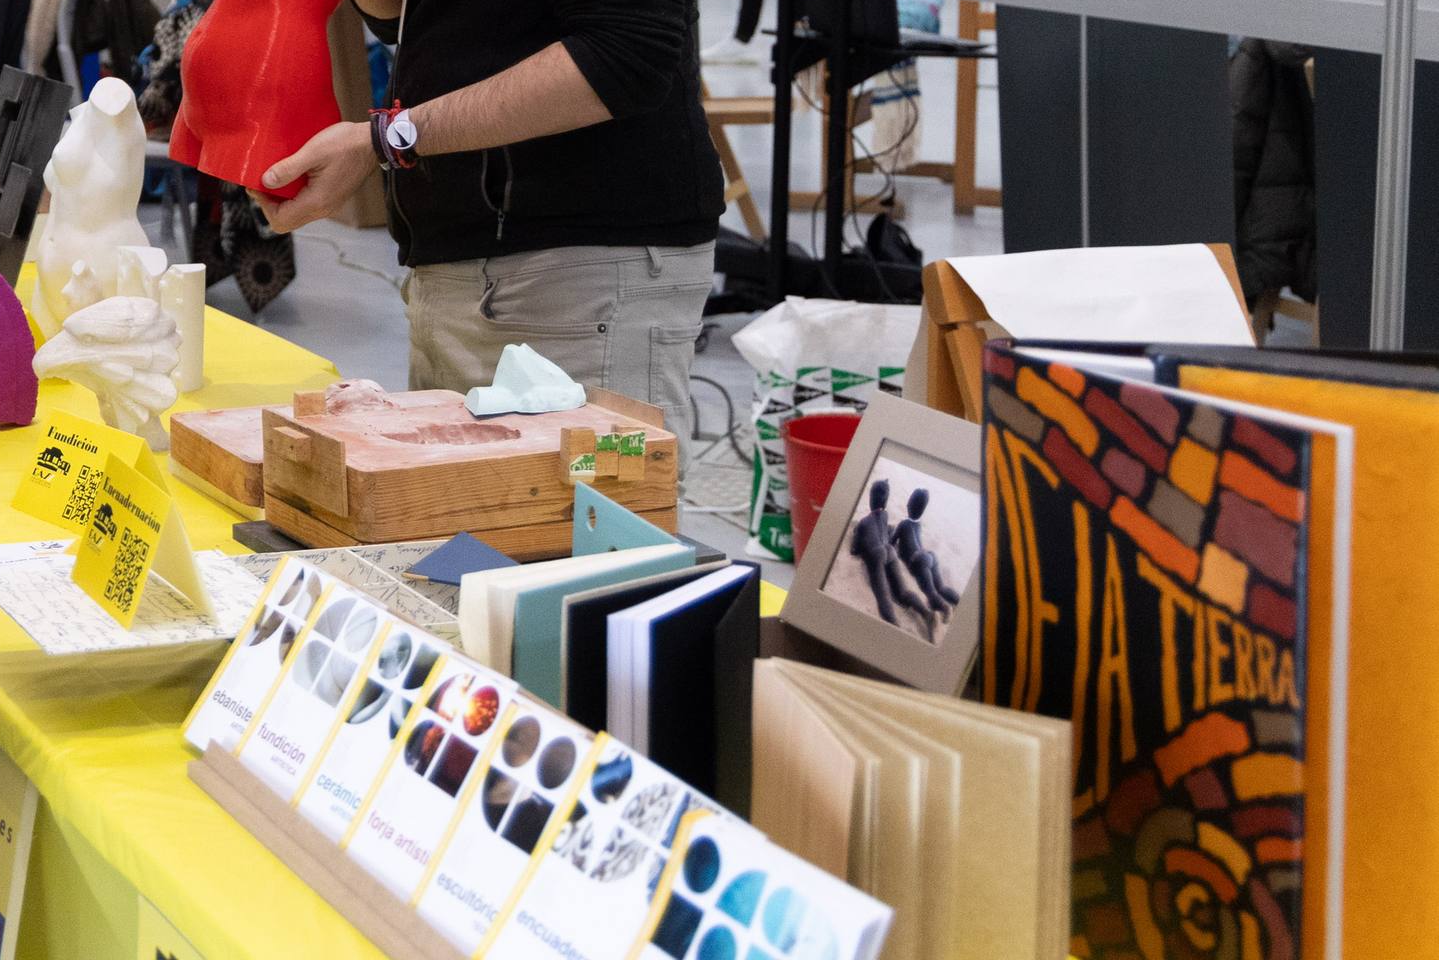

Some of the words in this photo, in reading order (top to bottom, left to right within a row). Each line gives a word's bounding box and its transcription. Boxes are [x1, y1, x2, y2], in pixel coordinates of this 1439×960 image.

[47, 425, 99, 455] Fundición
[103, 476, 161, 534] Encuadernación
[1136, 551, 1302, 734] TIERRA
[257, 722, 307, 765] fundición
[367, 809, 395, 839] forja
